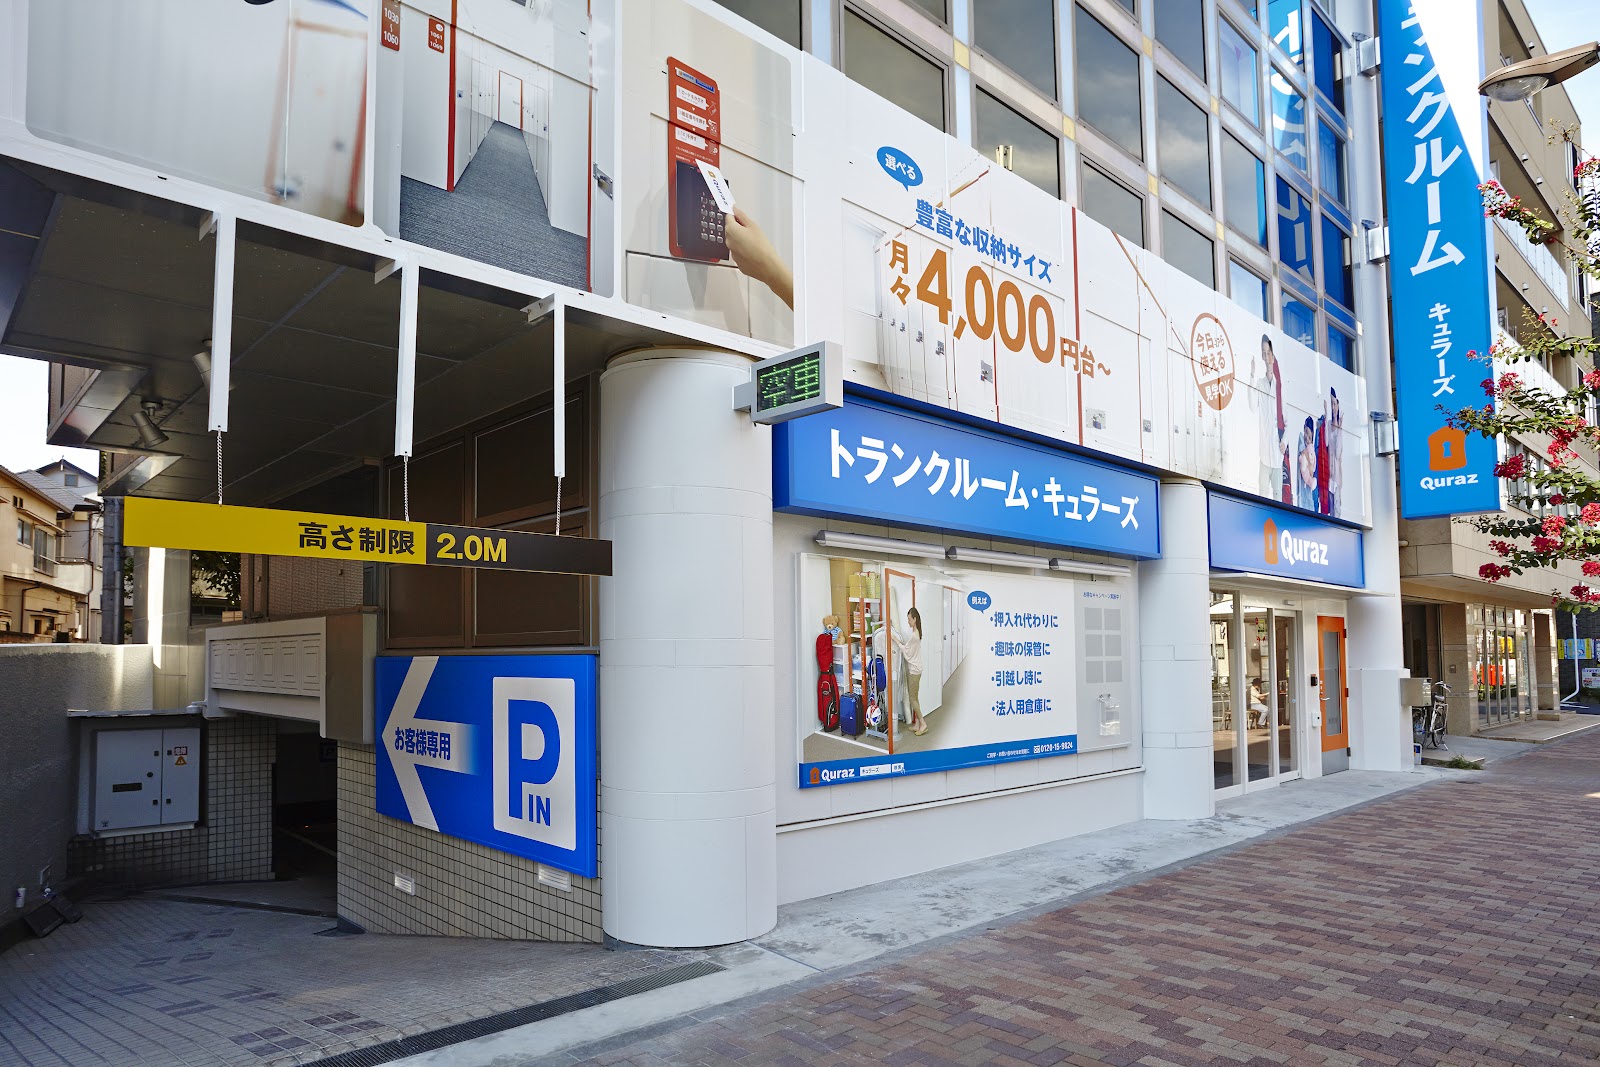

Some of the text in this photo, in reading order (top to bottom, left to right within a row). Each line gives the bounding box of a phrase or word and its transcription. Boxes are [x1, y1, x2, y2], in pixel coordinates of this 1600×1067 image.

[384, 7, 399, 24] 1030
[383, 30, 399, 46] 1060
[884, 152, 916, 180] 選べる
[915, 198, 1052, 284] 豊富な収納サイズ
[888, 239, 911, 306] 月々
[1199, 350, 1226, 376] 使える
[1428, 301, 1456, 398] キュラーズ
[760, 356, 820, 411] 空車
[1204, 378, 1233, 402] 見学OK
[830, 428, 1140, 531] トランクルーム・キュラーズ
[1420, 473, 1479, 491] Quraz
[298, 521, 508, 564] 高さ制限 2.0M
[1280, 529, 1329, 566] Quraz
[971, 596, 988, 605] 例えば
[394, 726, 451, 761] お客様専用
[507, 698, 561, 820] P
[821, 768, 855, 782] Quraz
[528, 793, 551, 827] IN
